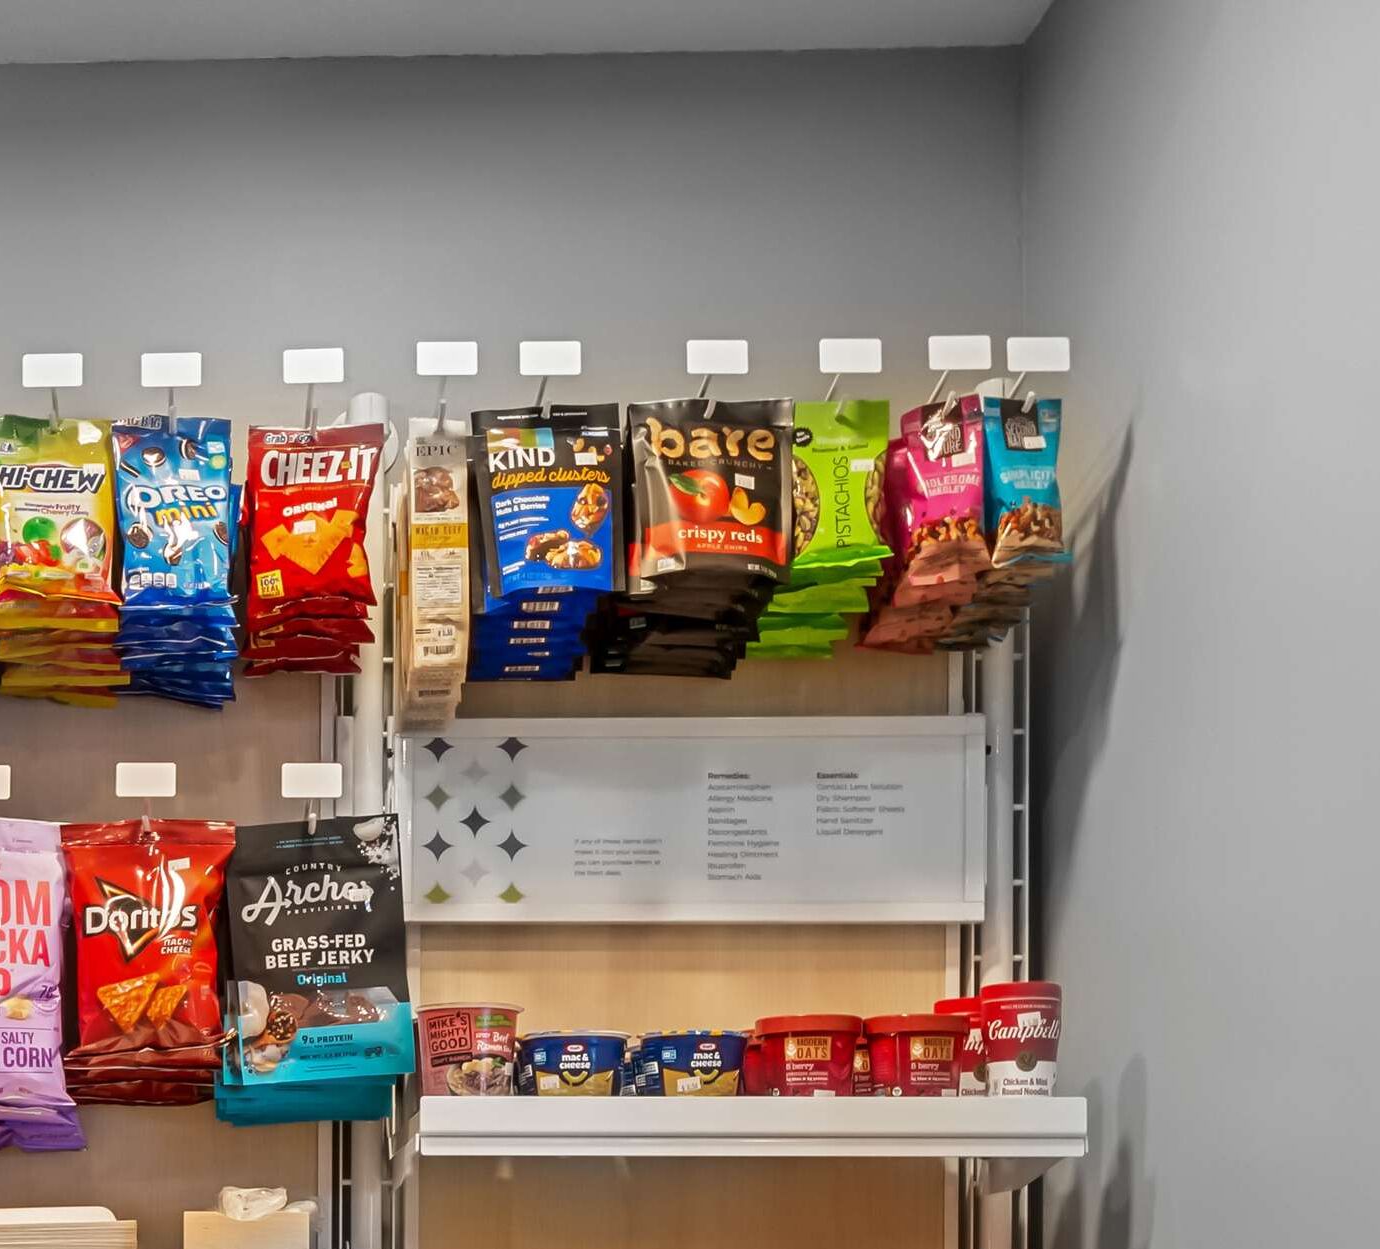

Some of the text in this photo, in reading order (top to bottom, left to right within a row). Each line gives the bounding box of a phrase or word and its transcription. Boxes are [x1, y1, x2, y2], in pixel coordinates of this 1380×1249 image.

[646, 417, 776, 461] bare
[261, 446, 377, 487] CHEEZ-IT
[489, 449, 555, 472] KIND
[492, 466, 611, 490] dipped clusters
[127, 484, 227, 514] OREO
[495, 499, 512, 508] Dark
[833, 456, 851, 549] PISTACHIOS
[56, 503, 81, 511] Fruity
[155, 502, 218, 525] mini
[678, 526, 763, 544] crispy reds
[285, 862, 341, 875] COUNTRY
[271, 934, 366, 952] GRASS-FED
[265, 949, 374, 970] BEEF JERKY
[297, 972, 348, 987] Original
[429, 1015, 467, 1029] MIKE'S
[2, 1032, 34, 1045] SALTY
[301, 1033, 353, 1045] 9G PROTEIN
[429, 1027, 467, 1039] MIGHTY
[432, 1037, 467, 1051] GOOD
[3, 1047, 53, 1069] CORN
[562, 1053, 589, 1062] mac &
[693, 1051, 720, 1061] mac &
[797, 1046, 828, 1058] OATS
[924, 1047, 951, 1058] OATS
[559, 1061, 591, 1070] cheese
[690, 1060, 722, 1068] cheese
[792, 1063, 814, 1071] berry
